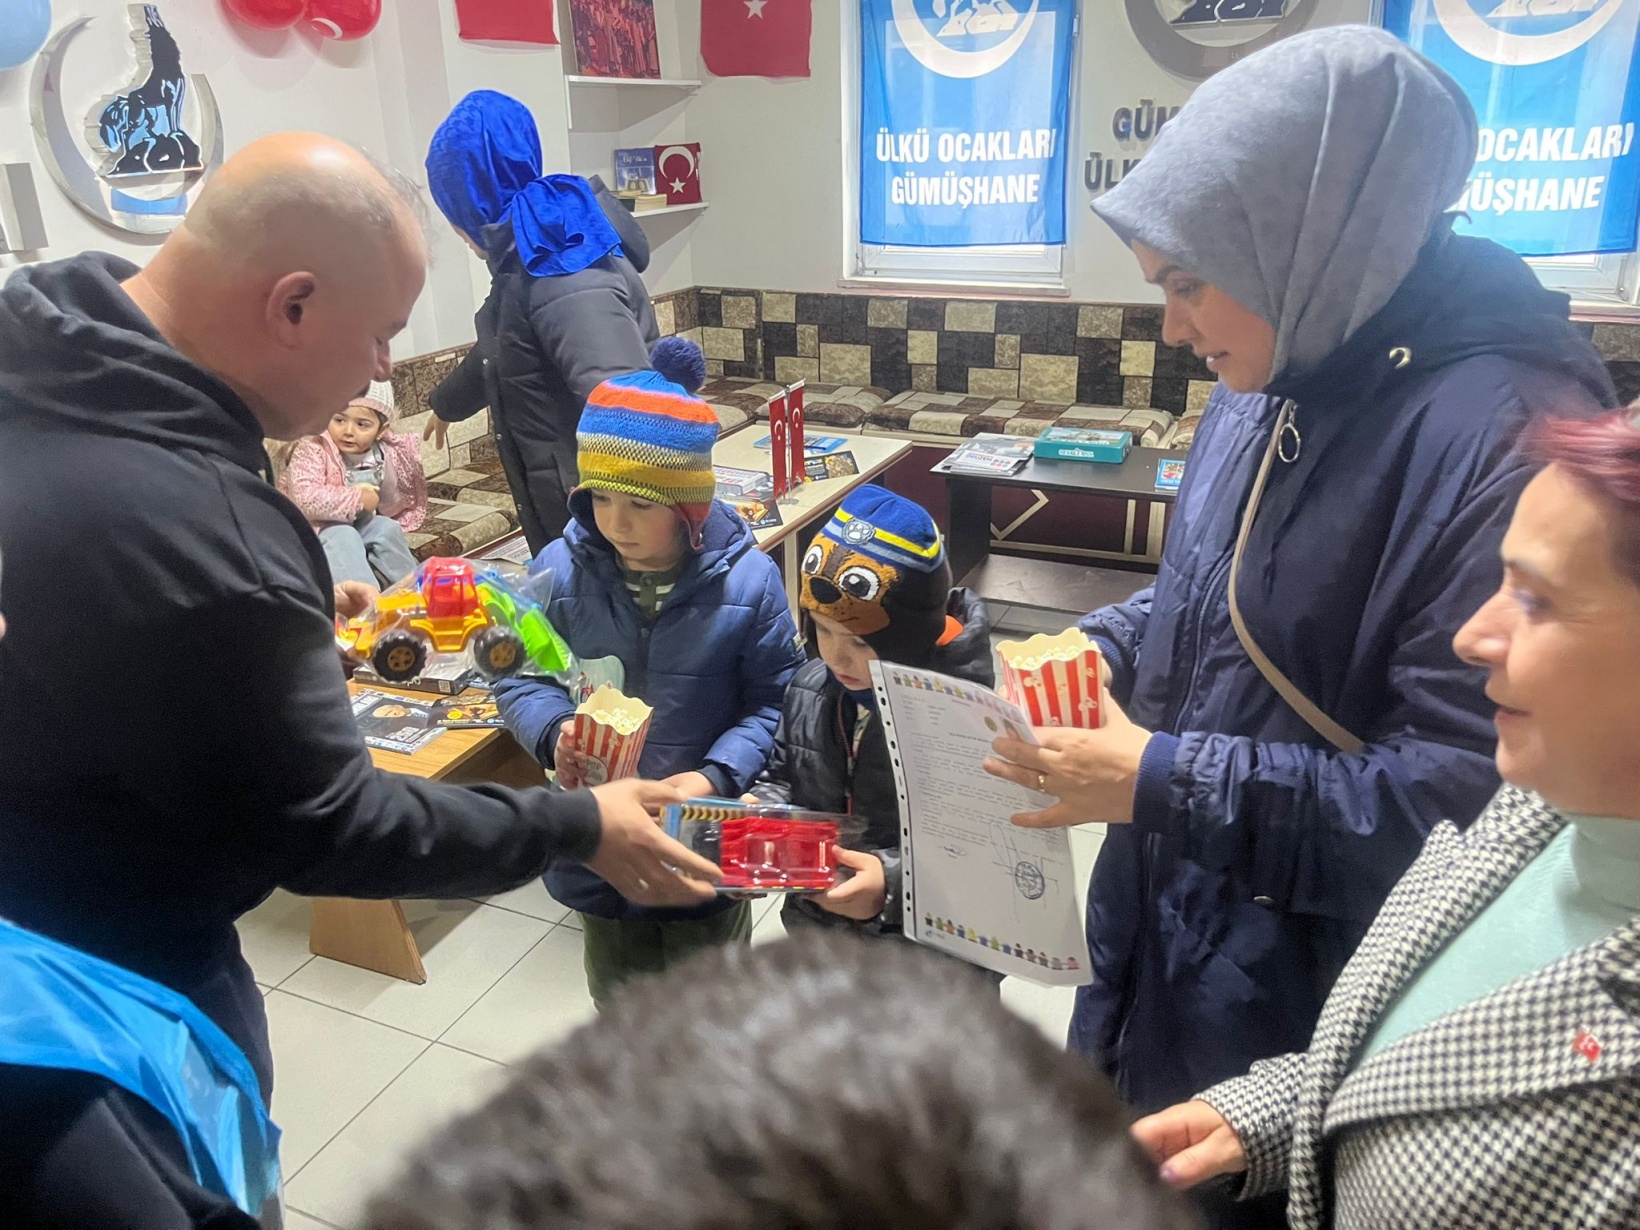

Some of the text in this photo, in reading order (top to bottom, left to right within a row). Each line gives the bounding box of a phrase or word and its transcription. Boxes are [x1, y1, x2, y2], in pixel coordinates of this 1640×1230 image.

[876, 127, 1057, 163] ÜLKÜ OCAKLARI
[1475, 122, 1635, 162] OCAKLARI
[891, 171, 1041, 209] GÜMÜŞHANE
